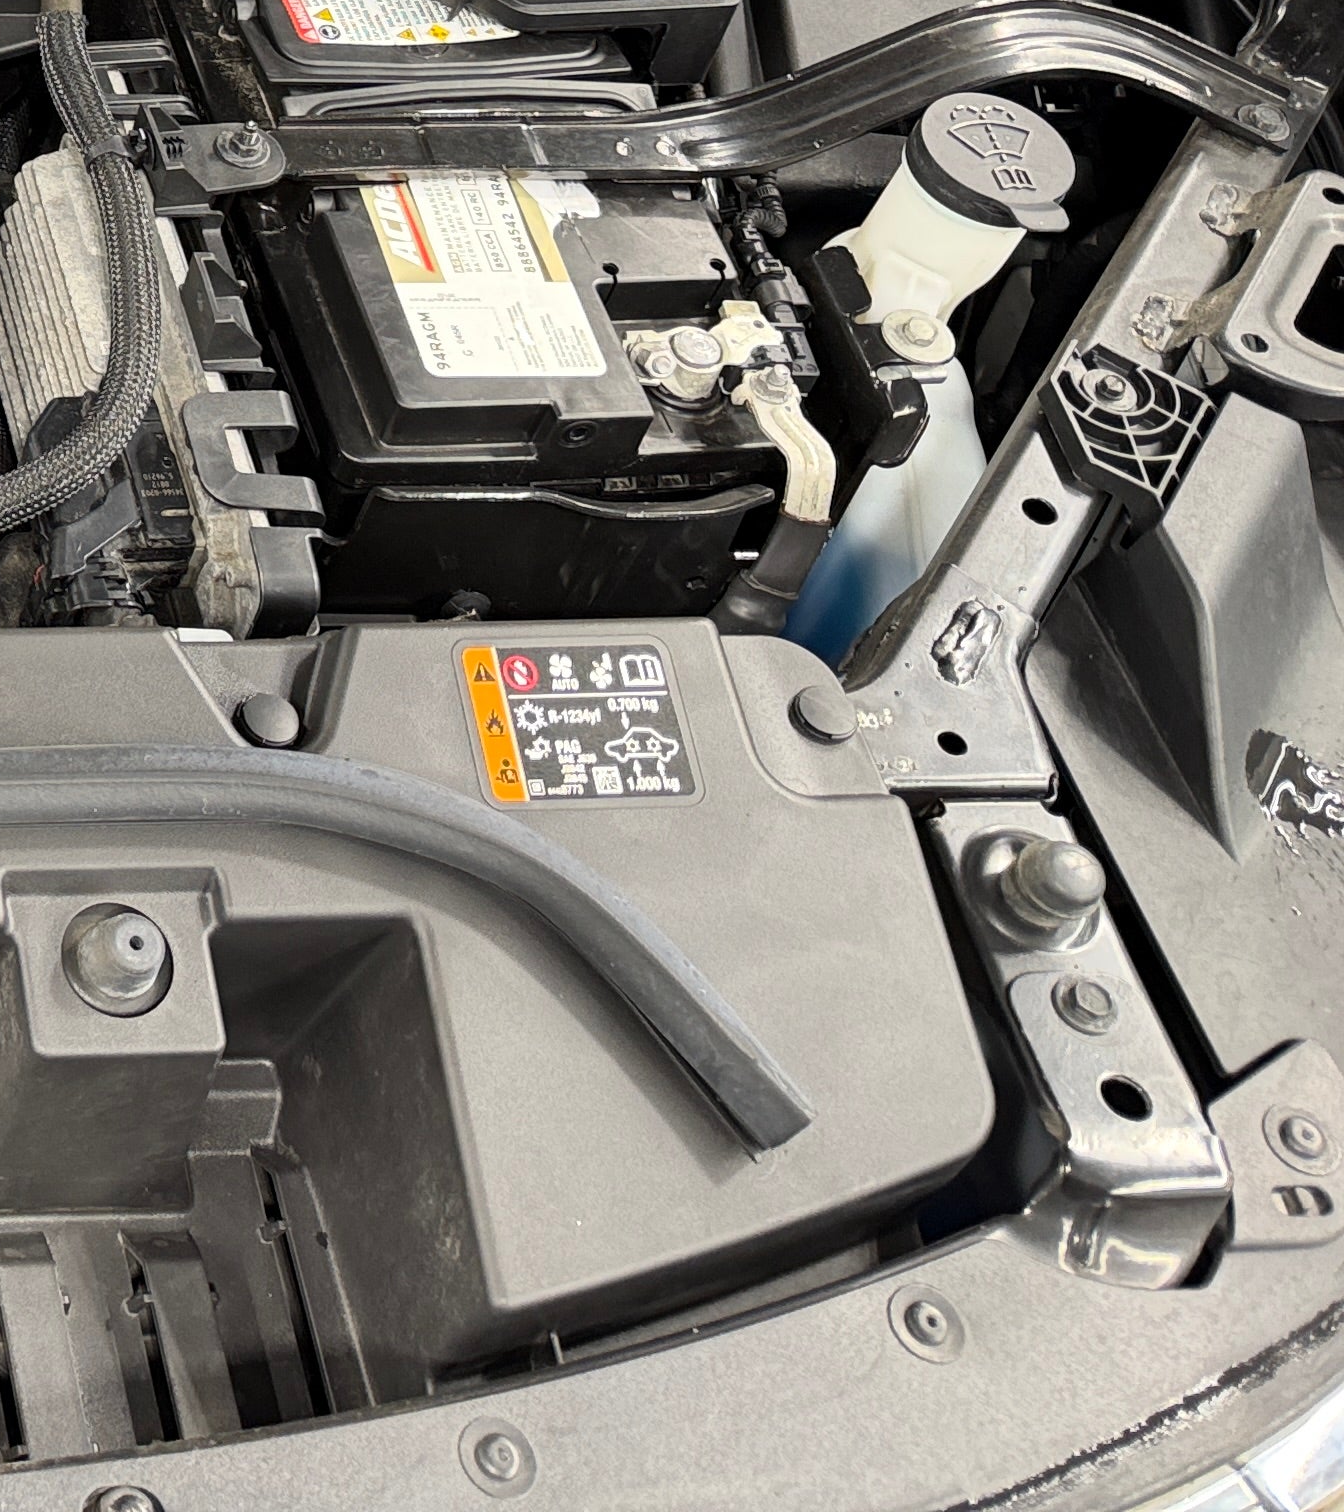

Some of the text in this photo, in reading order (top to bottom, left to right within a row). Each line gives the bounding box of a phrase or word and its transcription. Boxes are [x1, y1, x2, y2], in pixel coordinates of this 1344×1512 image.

[466, 192, 485, 221] 140 RC
[482, 233, 496, 249] CCA
[501, 213, 536, 272] 88864542
[416, 311, 451, 369] 94RAGM
[552, 677, 579, 691] AUTO
[607, 697, 659, 713] 0.700 kg
[554, 739, 582, 754] PAG
[627, 775, 680, 792] 1.000 kg
